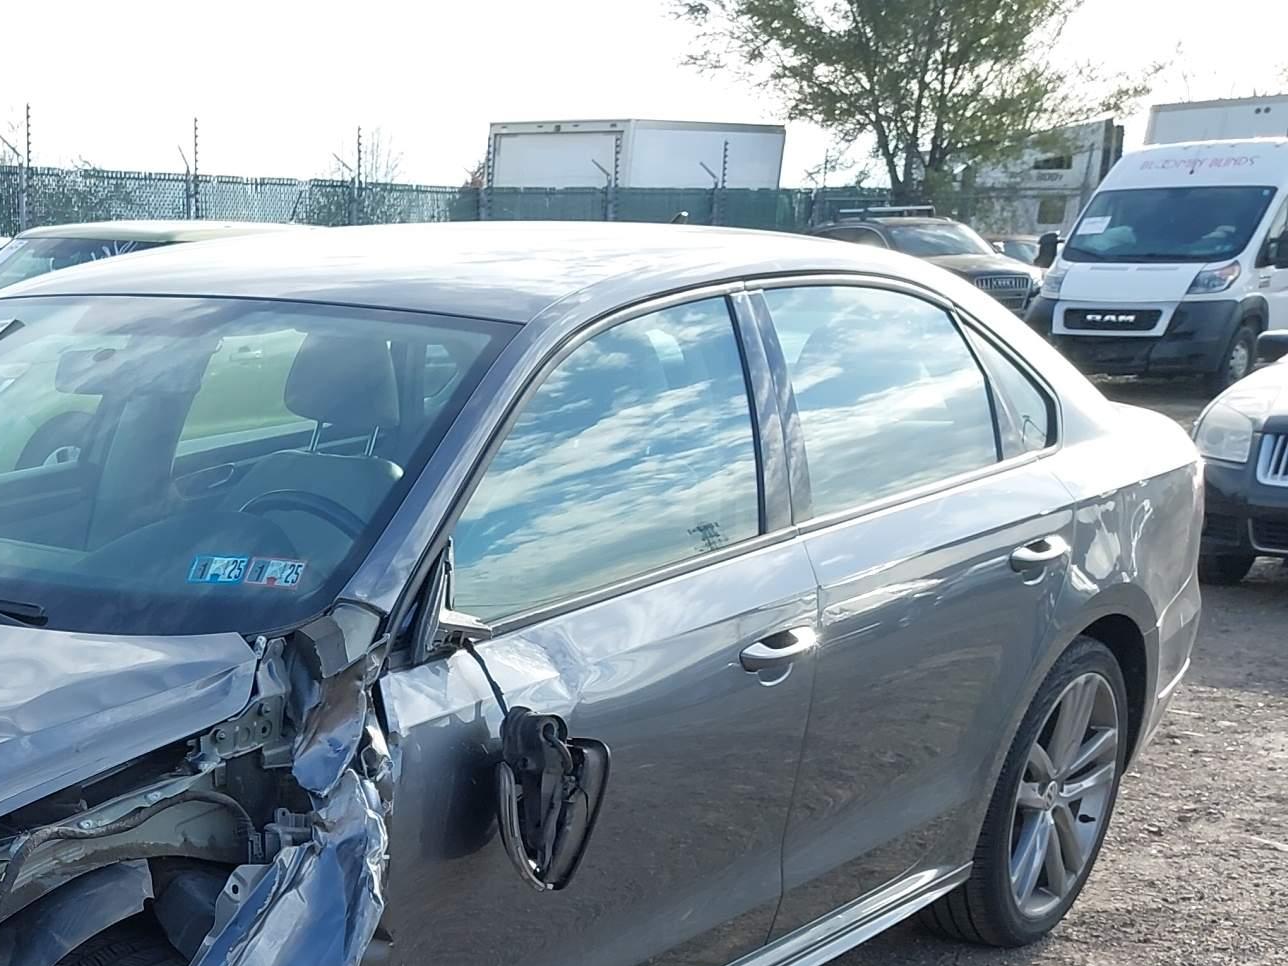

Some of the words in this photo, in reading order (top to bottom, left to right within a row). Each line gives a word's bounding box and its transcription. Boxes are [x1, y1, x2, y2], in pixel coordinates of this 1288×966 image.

[1086, 314, 1136, 323] RAM
[199, 563, 208, 579] 1
[227, 560, 245, 579] 25
[255, 565, 265, 582] 1
[284, 564, 303, 584] 25
